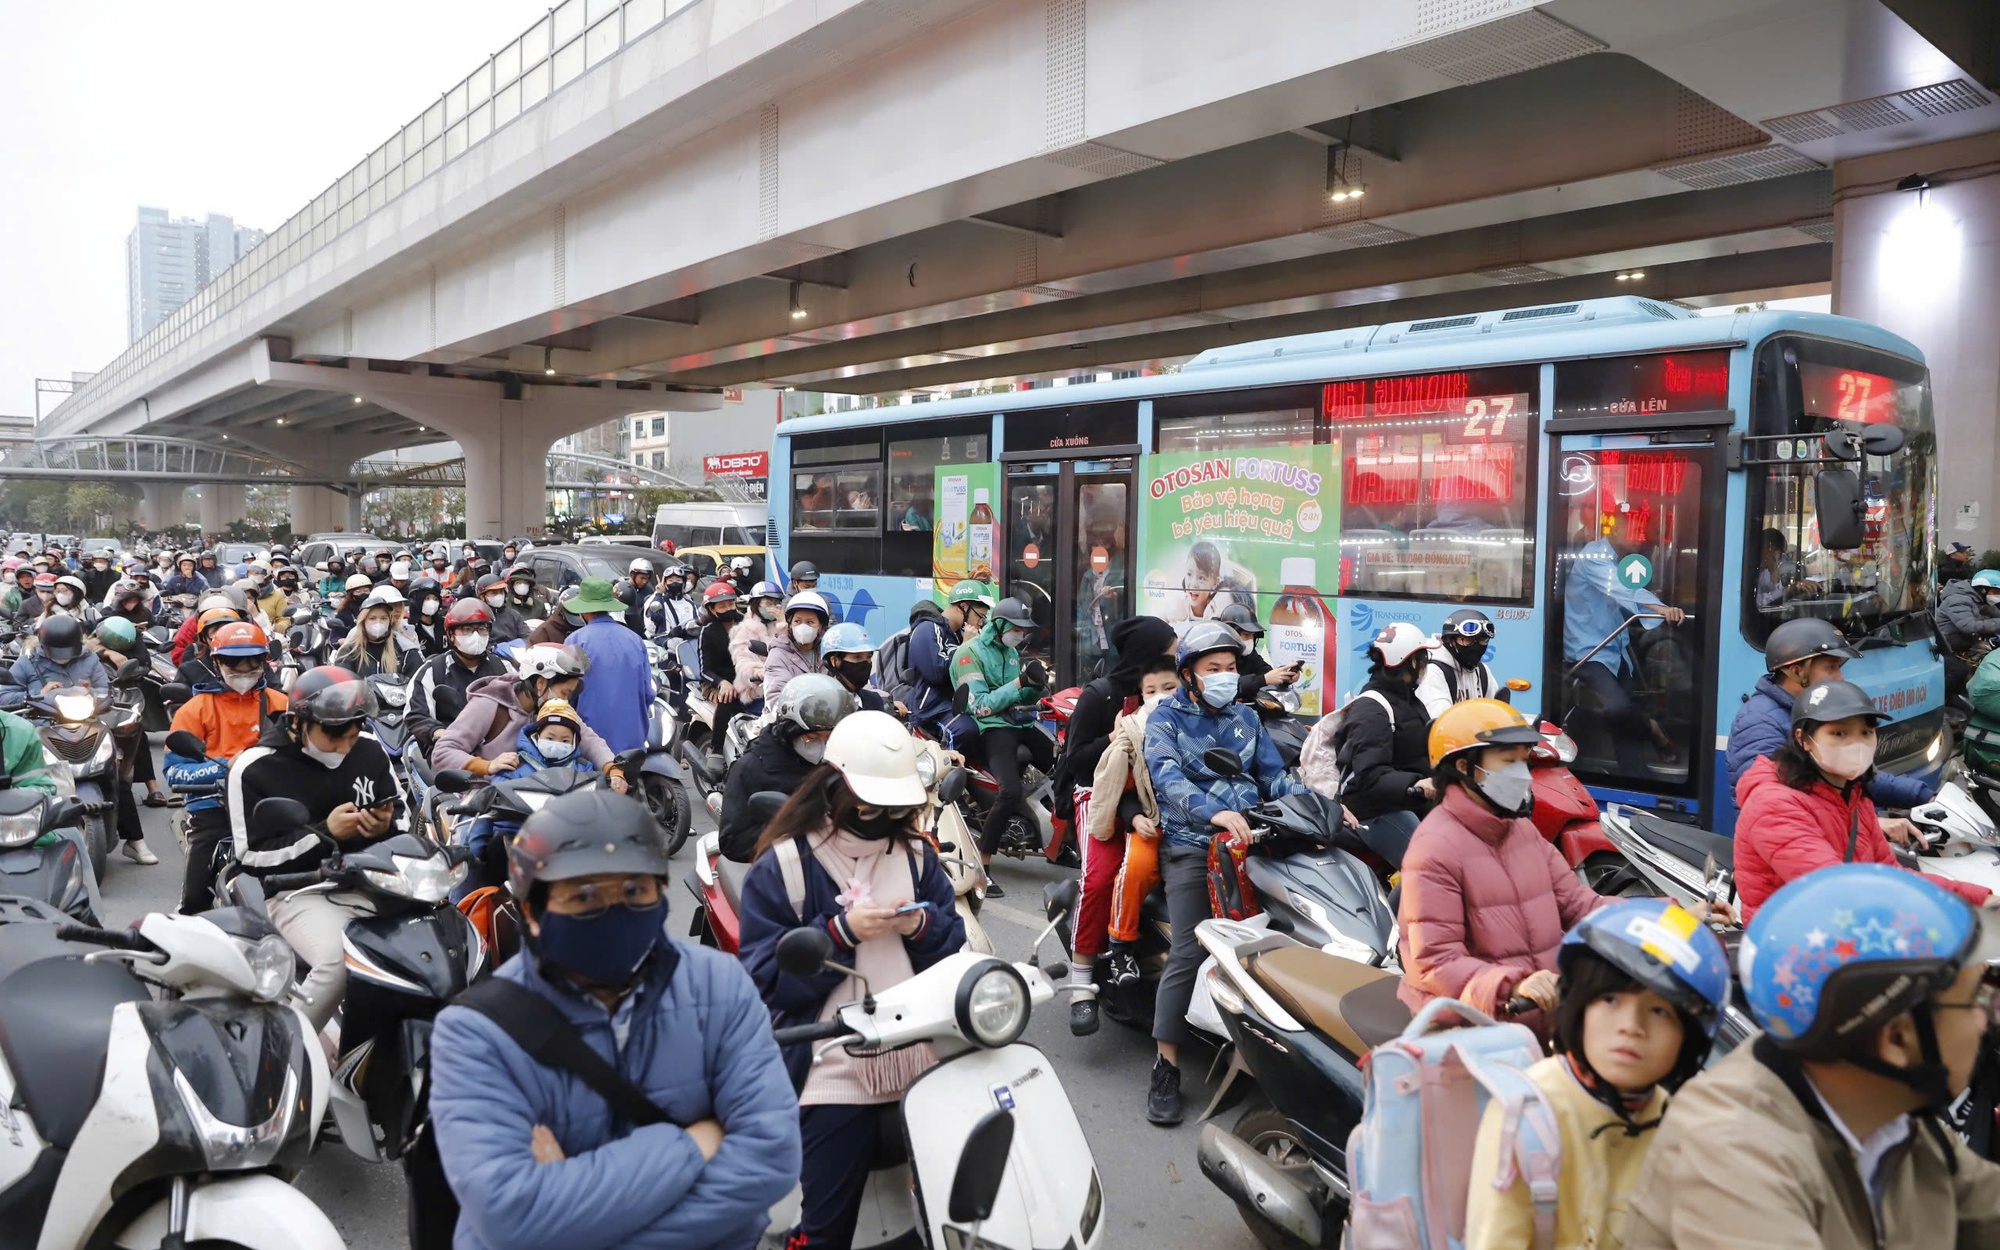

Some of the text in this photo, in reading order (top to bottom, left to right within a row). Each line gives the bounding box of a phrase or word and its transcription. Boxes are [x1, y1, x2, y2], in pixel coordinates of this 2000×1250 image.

[1641, 397, 1667, 412] LÊN
[1838, 374, 1871, 422] 27
[1463, 397, 1514, 436] 27
[1150, 457, 1322, 499] OTOSAN FORTUSS
[1181, 487, 1284, 515] Bảo vệ họng
[1302, 511, 1319, 521] 24h
[1172, 510, 1294, 539] bé yêu hiệu quả
[956, 586, 973, 594] Grab
[1373, 611, 1421, 622] TRANSERCO
[1495, 608, 1532, 620] BC095
[1279, 641, 1317, 652] FORTUSS
